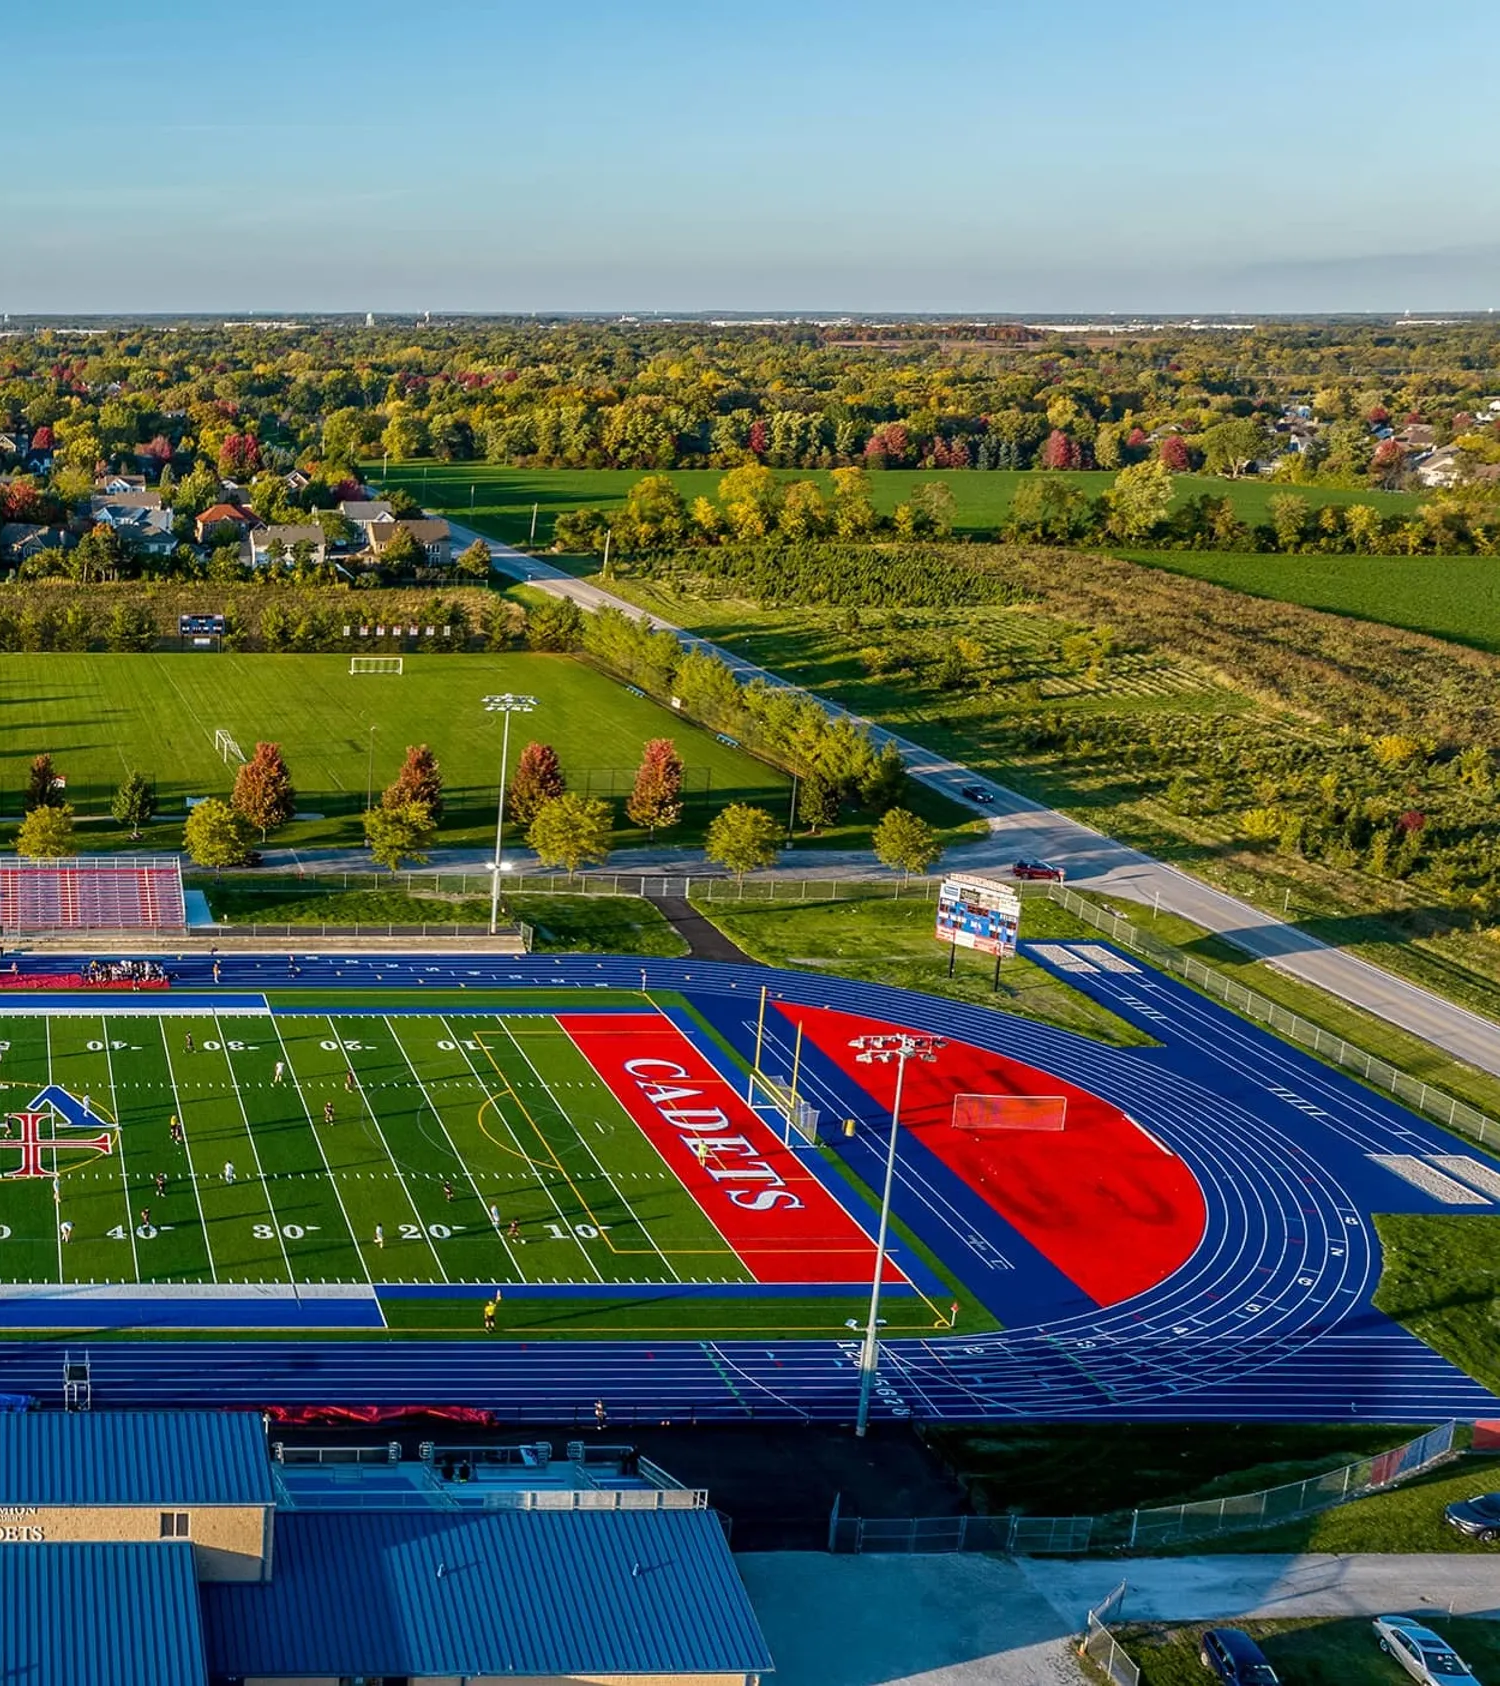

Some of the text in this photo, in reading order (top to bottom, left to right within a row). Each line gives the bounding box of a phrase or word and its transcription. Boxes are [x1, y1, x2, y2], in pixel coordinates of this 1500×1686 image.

[86, 1040, 128, 1051] 40
[202, 1040, 245, 1051] 30
[320, 1040, 364, 1051] 20
[437, 1040, 485, 1051] 10
[624, 1058, 805, 1210] CADETS
[106, 1225, 158, 1240] 40
[252, 1225, 305, 1240] 30
[399, 1225, 452, 1240] 20
[543, 1225, 599, 1240] 10
